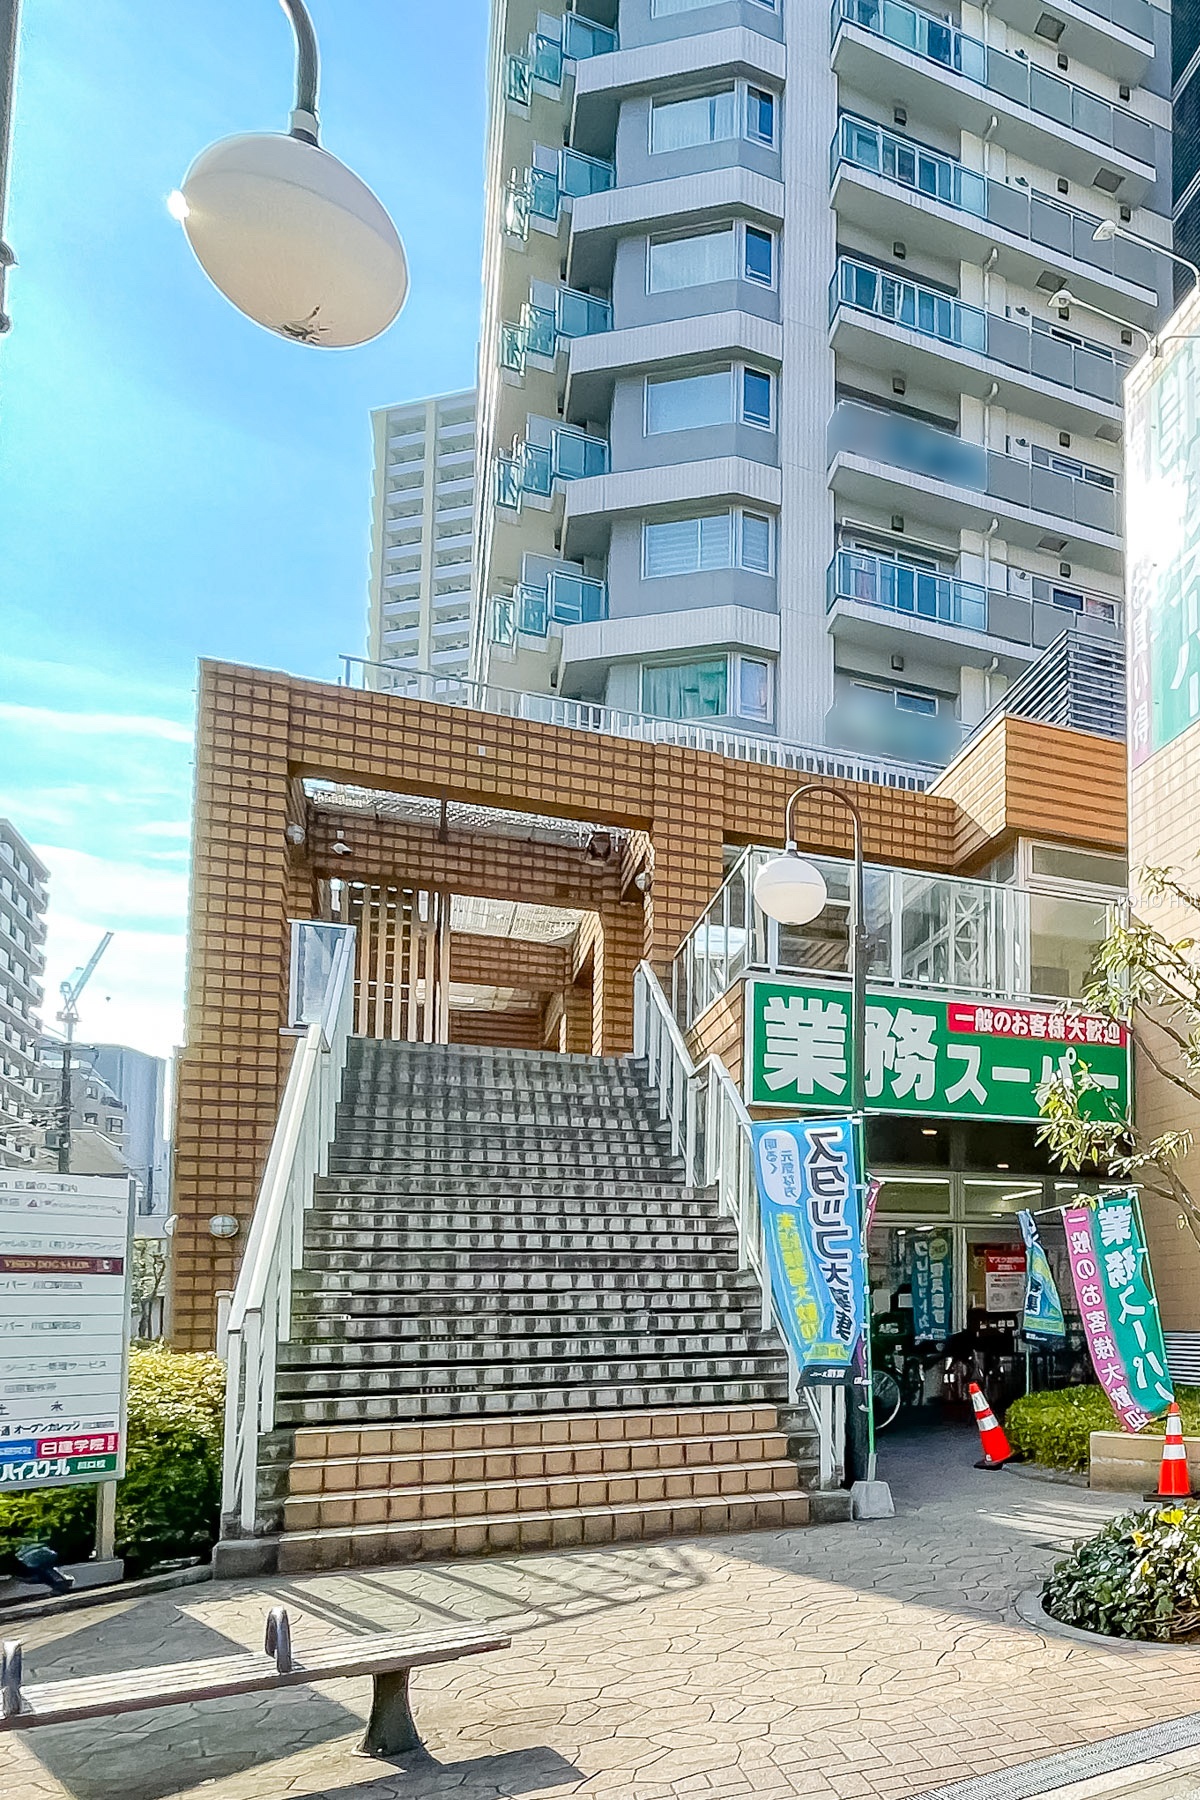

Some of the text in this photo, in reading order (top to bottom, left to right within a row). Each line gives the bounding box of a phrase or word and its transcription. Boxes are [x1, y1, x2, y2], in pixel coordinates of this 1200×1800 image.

[763, 996, 1120, 1106] 業務スーパー
[954, 1006, 1122, 1046] 一般のお客様大歓迎
